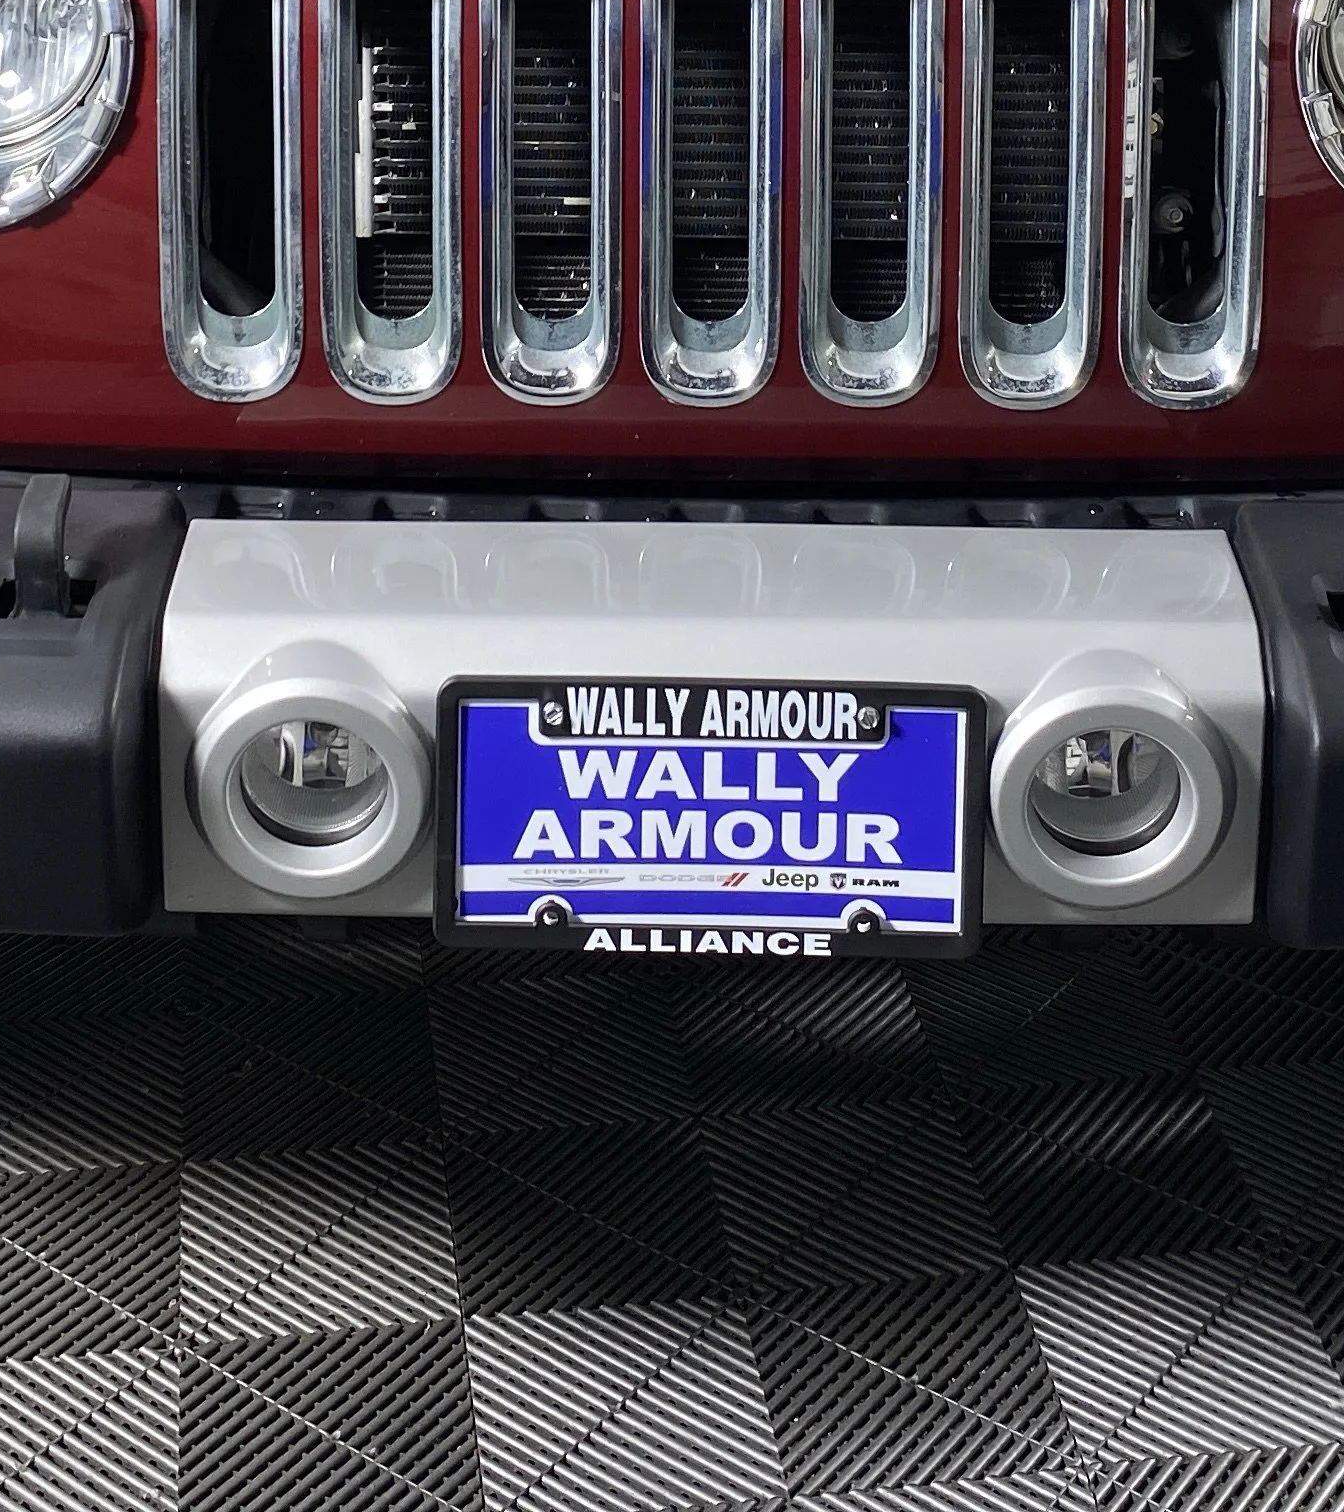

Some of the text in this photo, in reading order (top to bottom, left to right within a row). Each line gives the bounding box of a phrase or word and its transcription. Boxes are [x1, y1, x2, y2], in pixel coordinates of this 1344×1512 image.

[566, 686, 858, 740] WALLY ARMOUR
[557, 749, 860, 802] WALLY
[512, 809, 903, 864] ARMOUR
[523, 867, 610, 875] CHRYSLER
[761, 868, 820, 892] Jeep
[851, 877, 900, 888] RAM
[582, 927, 833, 957] ALLIANCE
